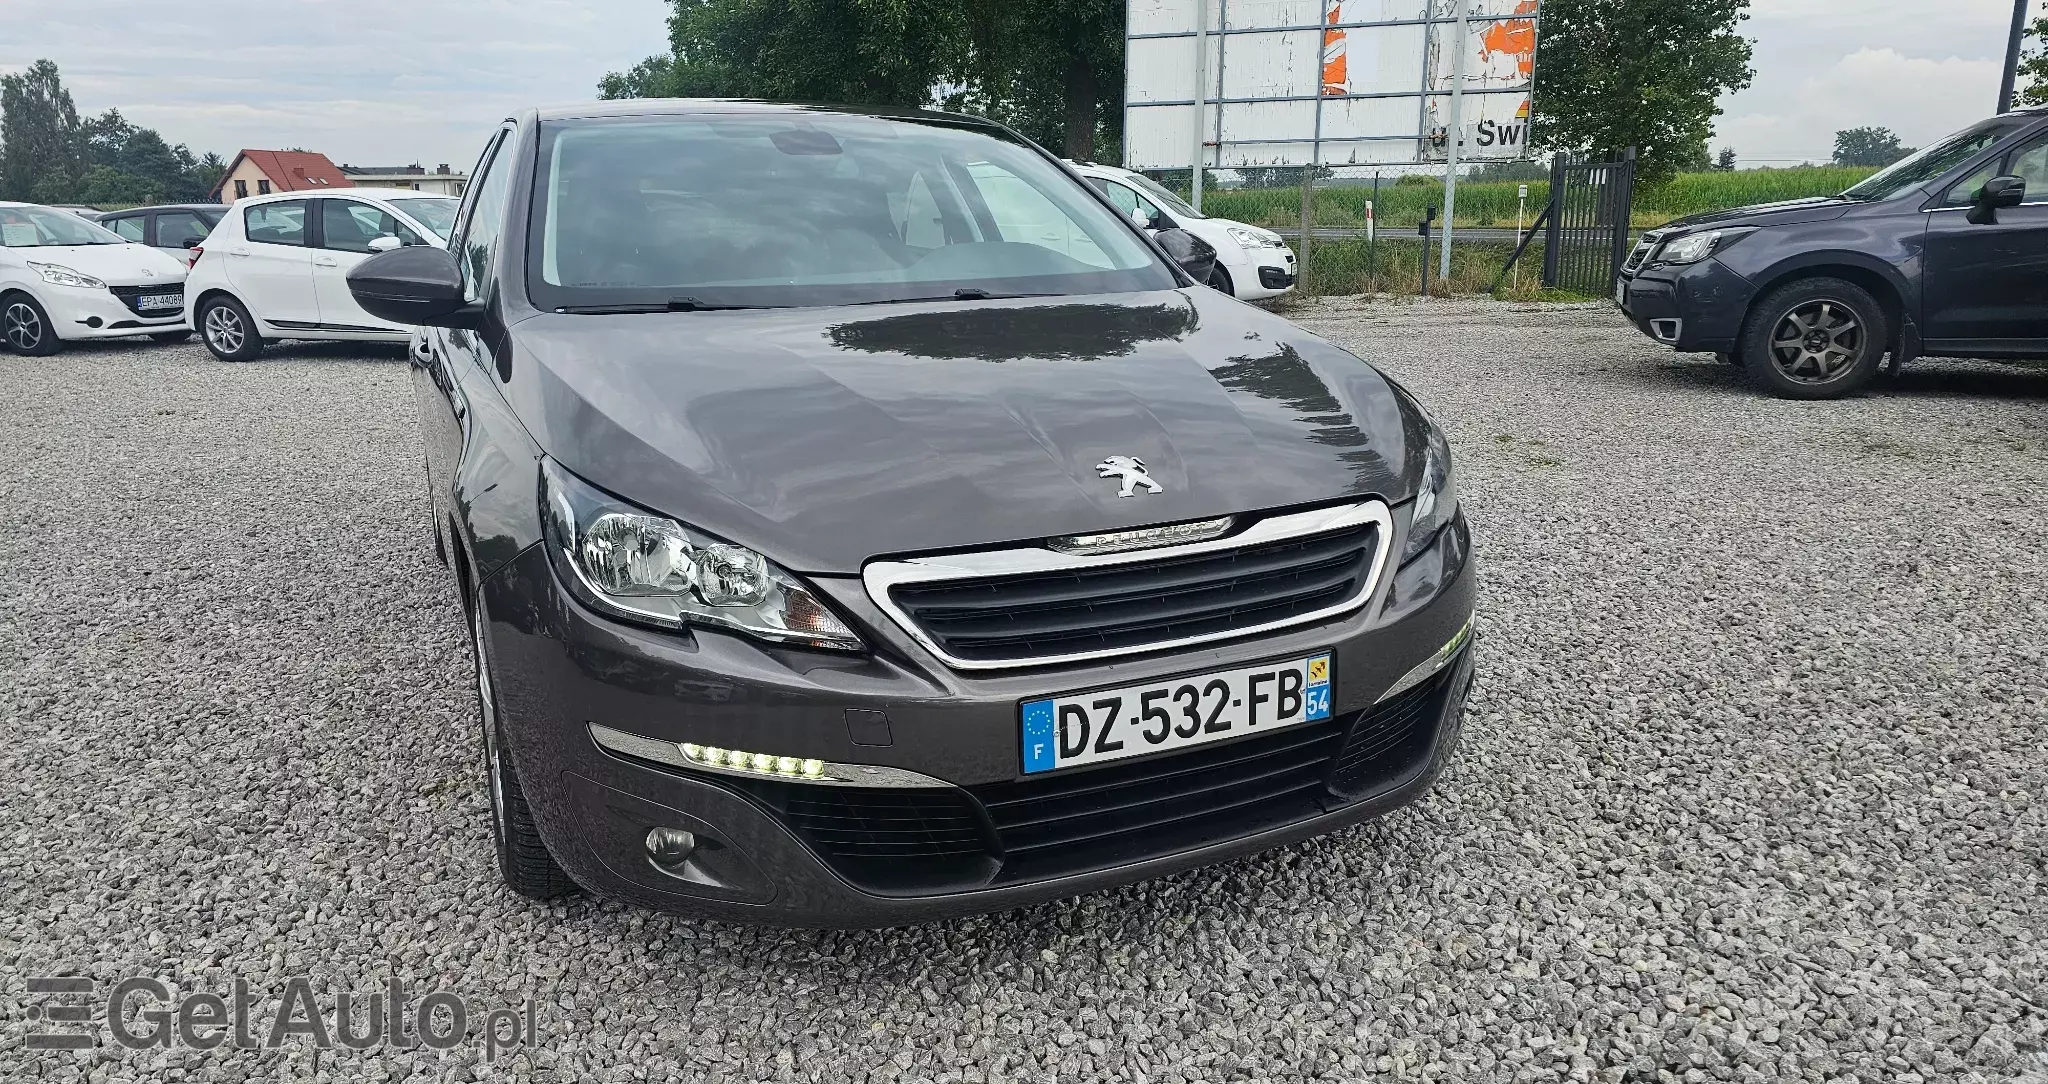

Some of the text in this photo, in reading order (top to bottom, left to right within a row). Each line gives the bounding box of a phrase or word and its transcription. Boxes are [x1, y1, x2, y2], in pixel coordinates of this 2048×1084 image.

[141, 296, 158, 307] EPA
[159, 294, 182, 305] 44089
[1307, 688, 1329, 715] 54
[1033, 743, 1044, 760] F
